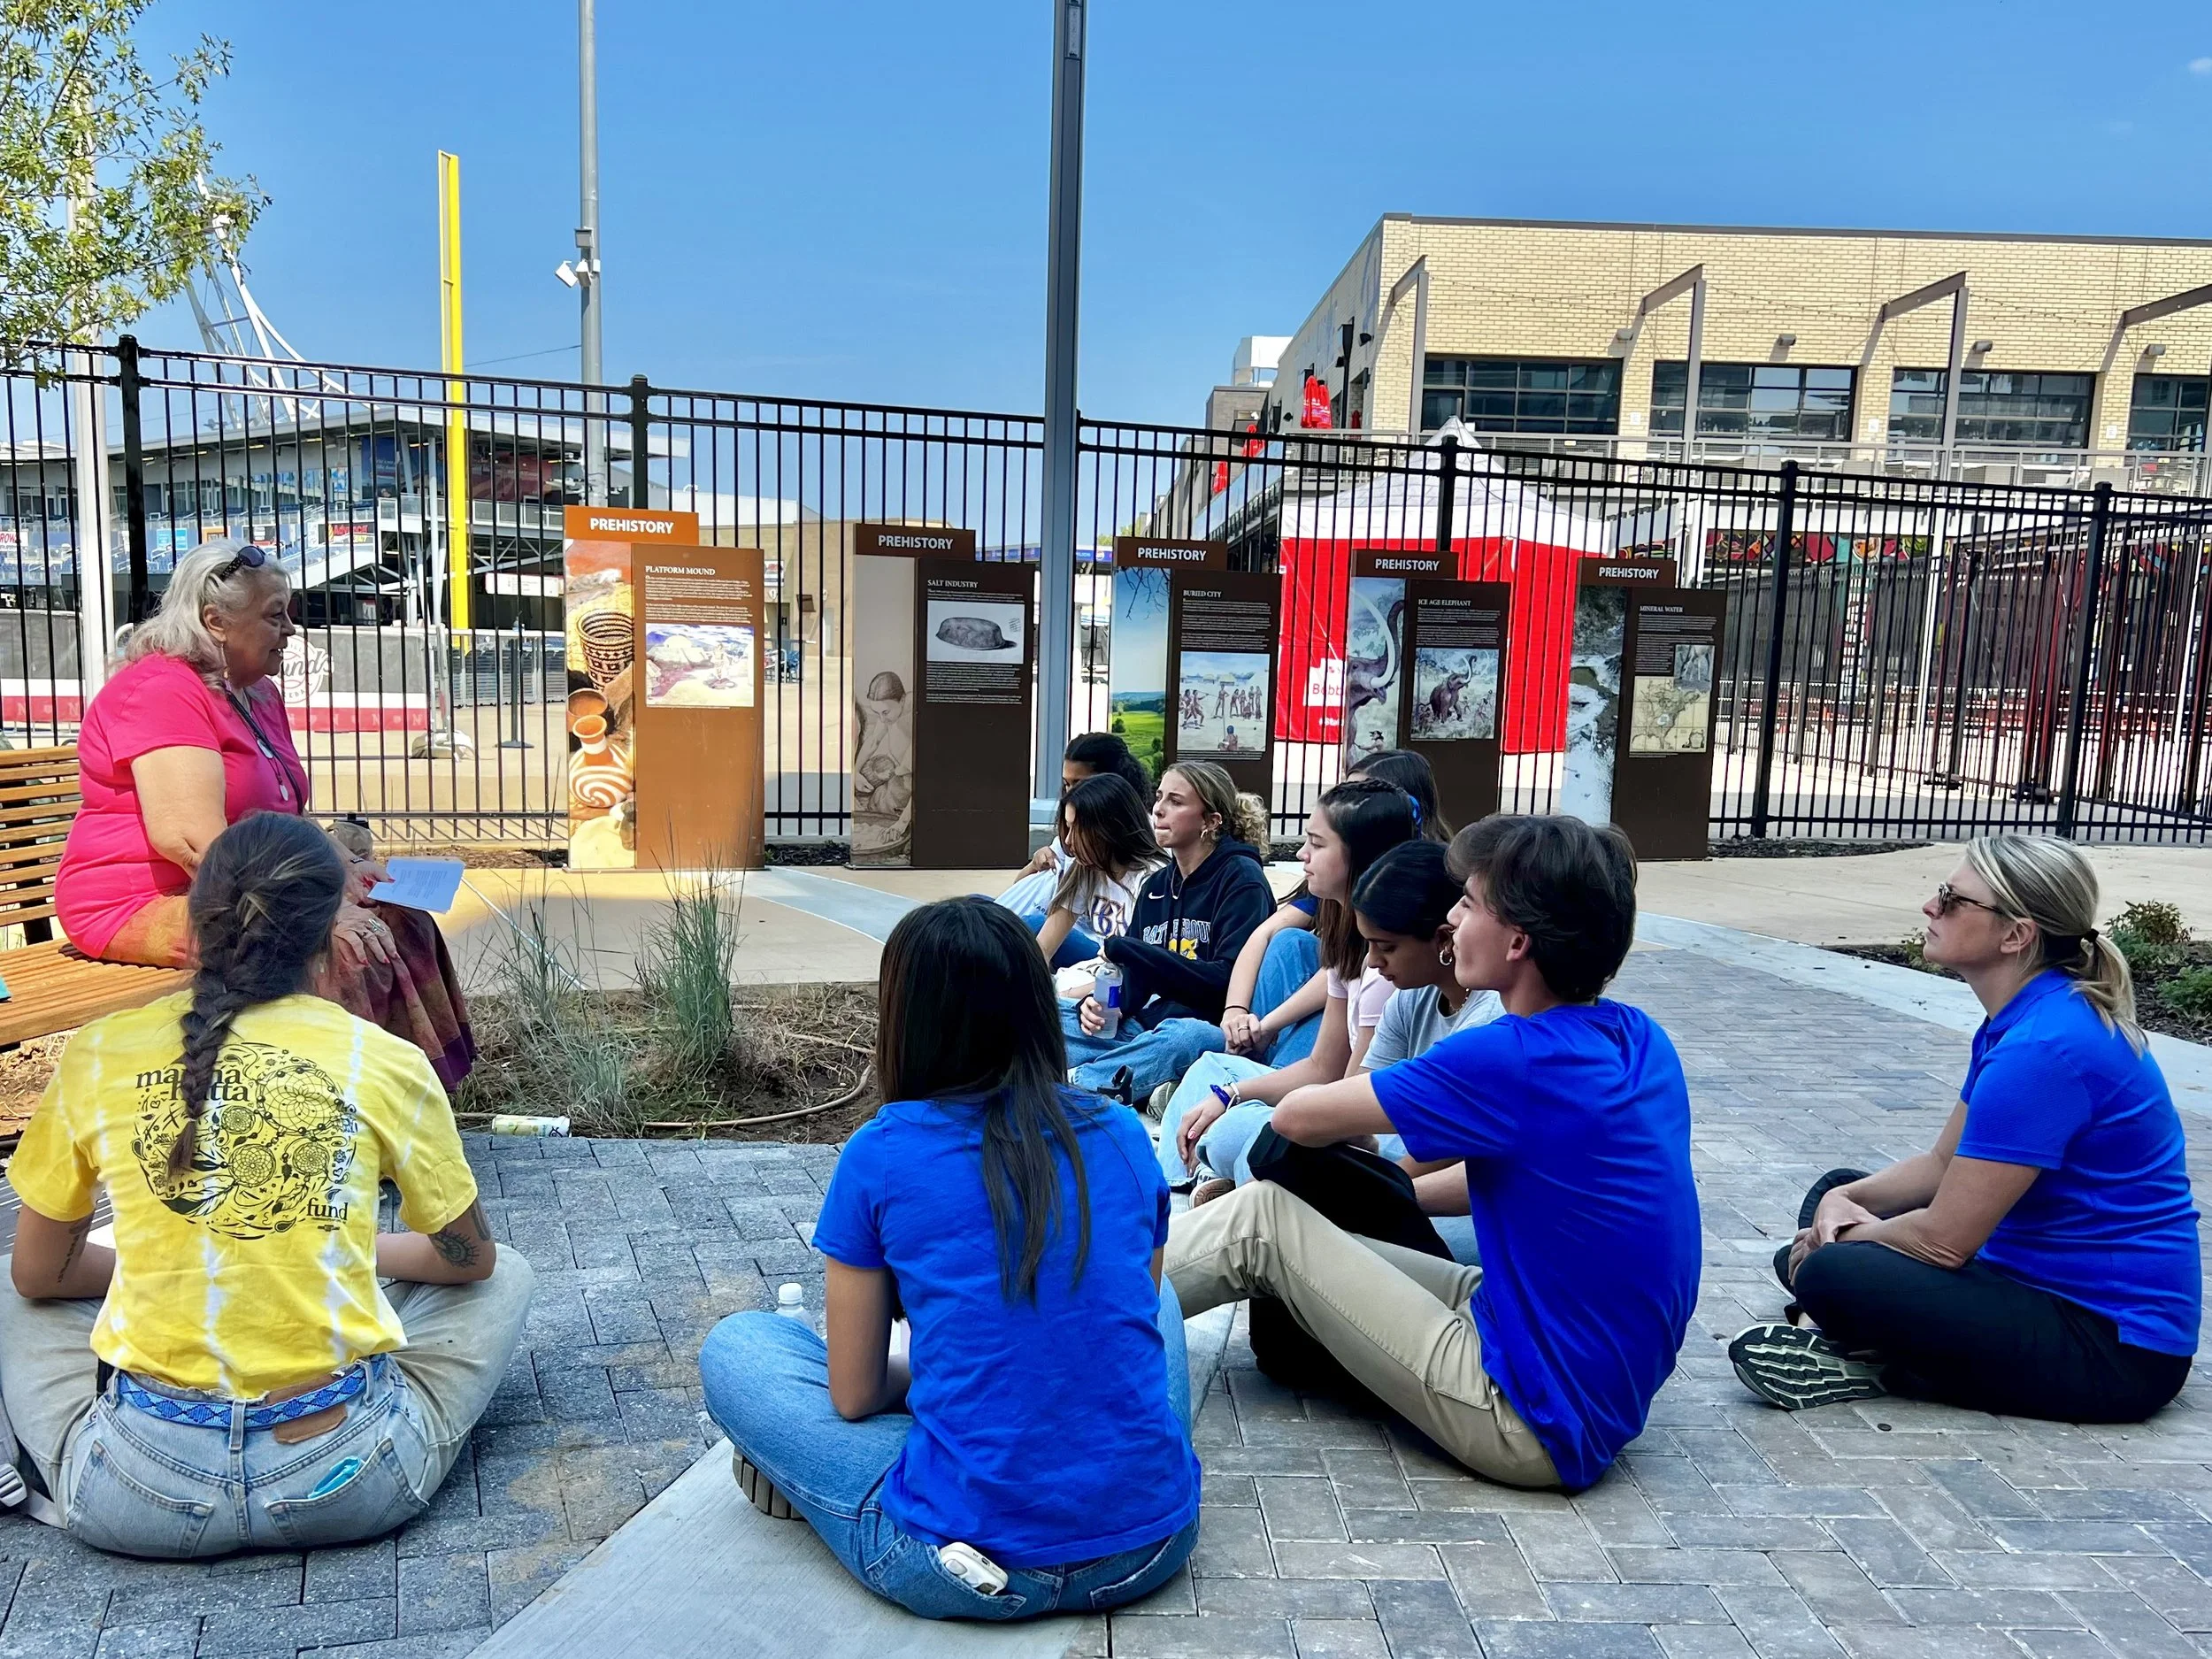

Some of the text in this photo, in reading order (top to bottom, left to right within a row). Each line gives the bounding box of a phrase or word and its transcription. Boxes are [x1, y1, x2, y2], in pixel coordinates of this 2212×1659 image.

[590, 518, 674, 534] PREHISTORY
[878, 534, 954, 549] PREHISTORY
[1138, 547, 1207, 562] PREHISTORY
[645, 565, 716, 576] PLATFORM MOUND
[1375, 558, 1440, 572] PREHISTORY
[1599, 566, 1659, 580] PREHISTORY
[945, 580, 979, 588] INDUSTRY
[306, 1197, 349, 1221] fund
